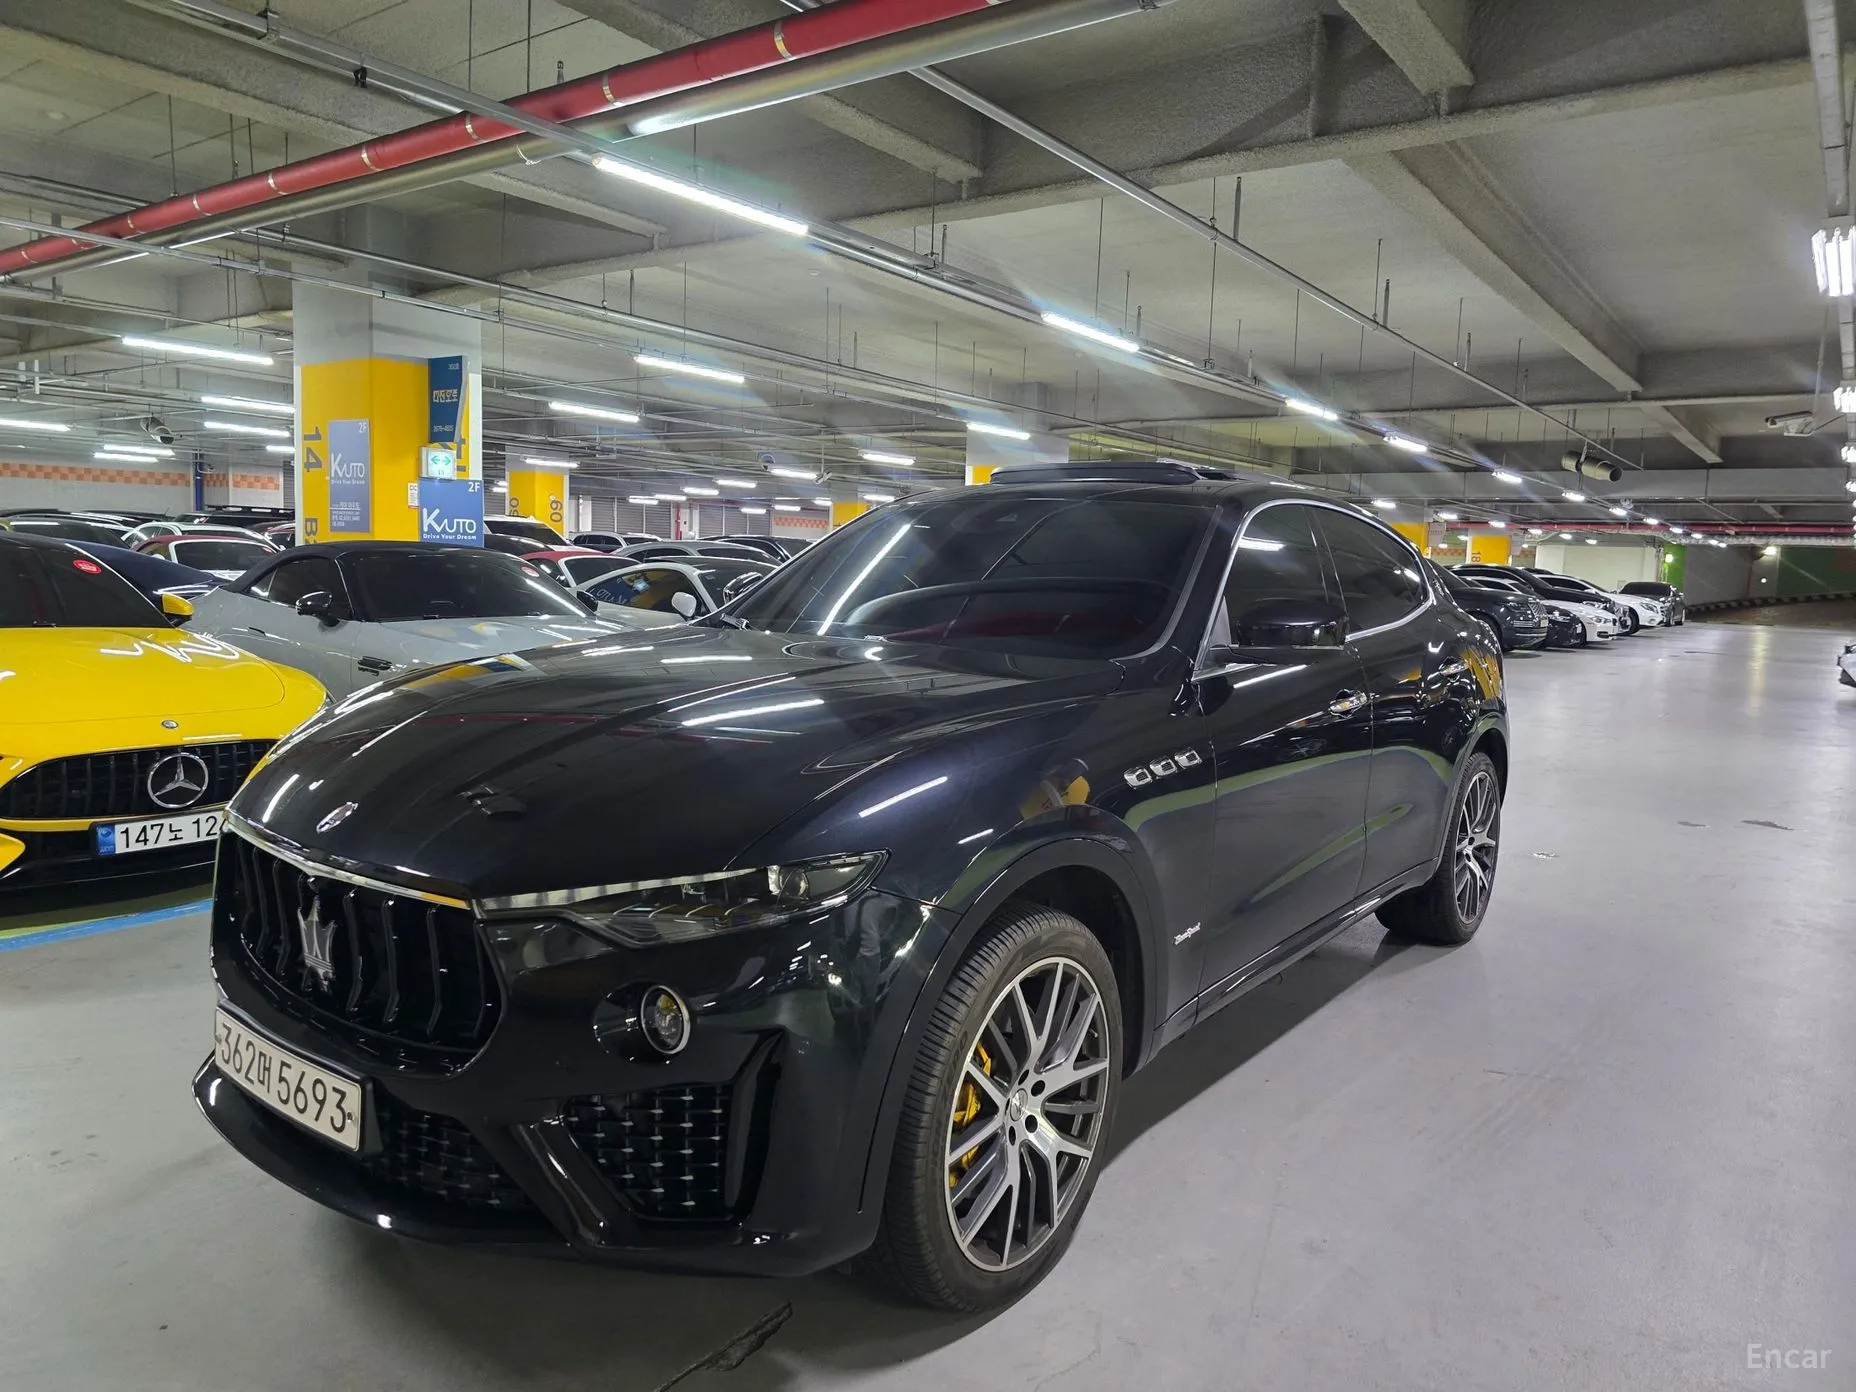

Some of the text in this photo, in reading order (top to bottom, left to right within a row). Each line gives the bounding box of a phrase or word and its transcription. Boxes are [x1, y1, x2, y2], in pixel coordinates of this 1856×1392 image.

[358, 422, 367, 433] 2F
[303, 426, 323, 473] 14
[468, 481, 481, 493] 2F
[120, 815, 226, 849] 147노 12
[221, 1023, 347, 1133] 362머 5693
